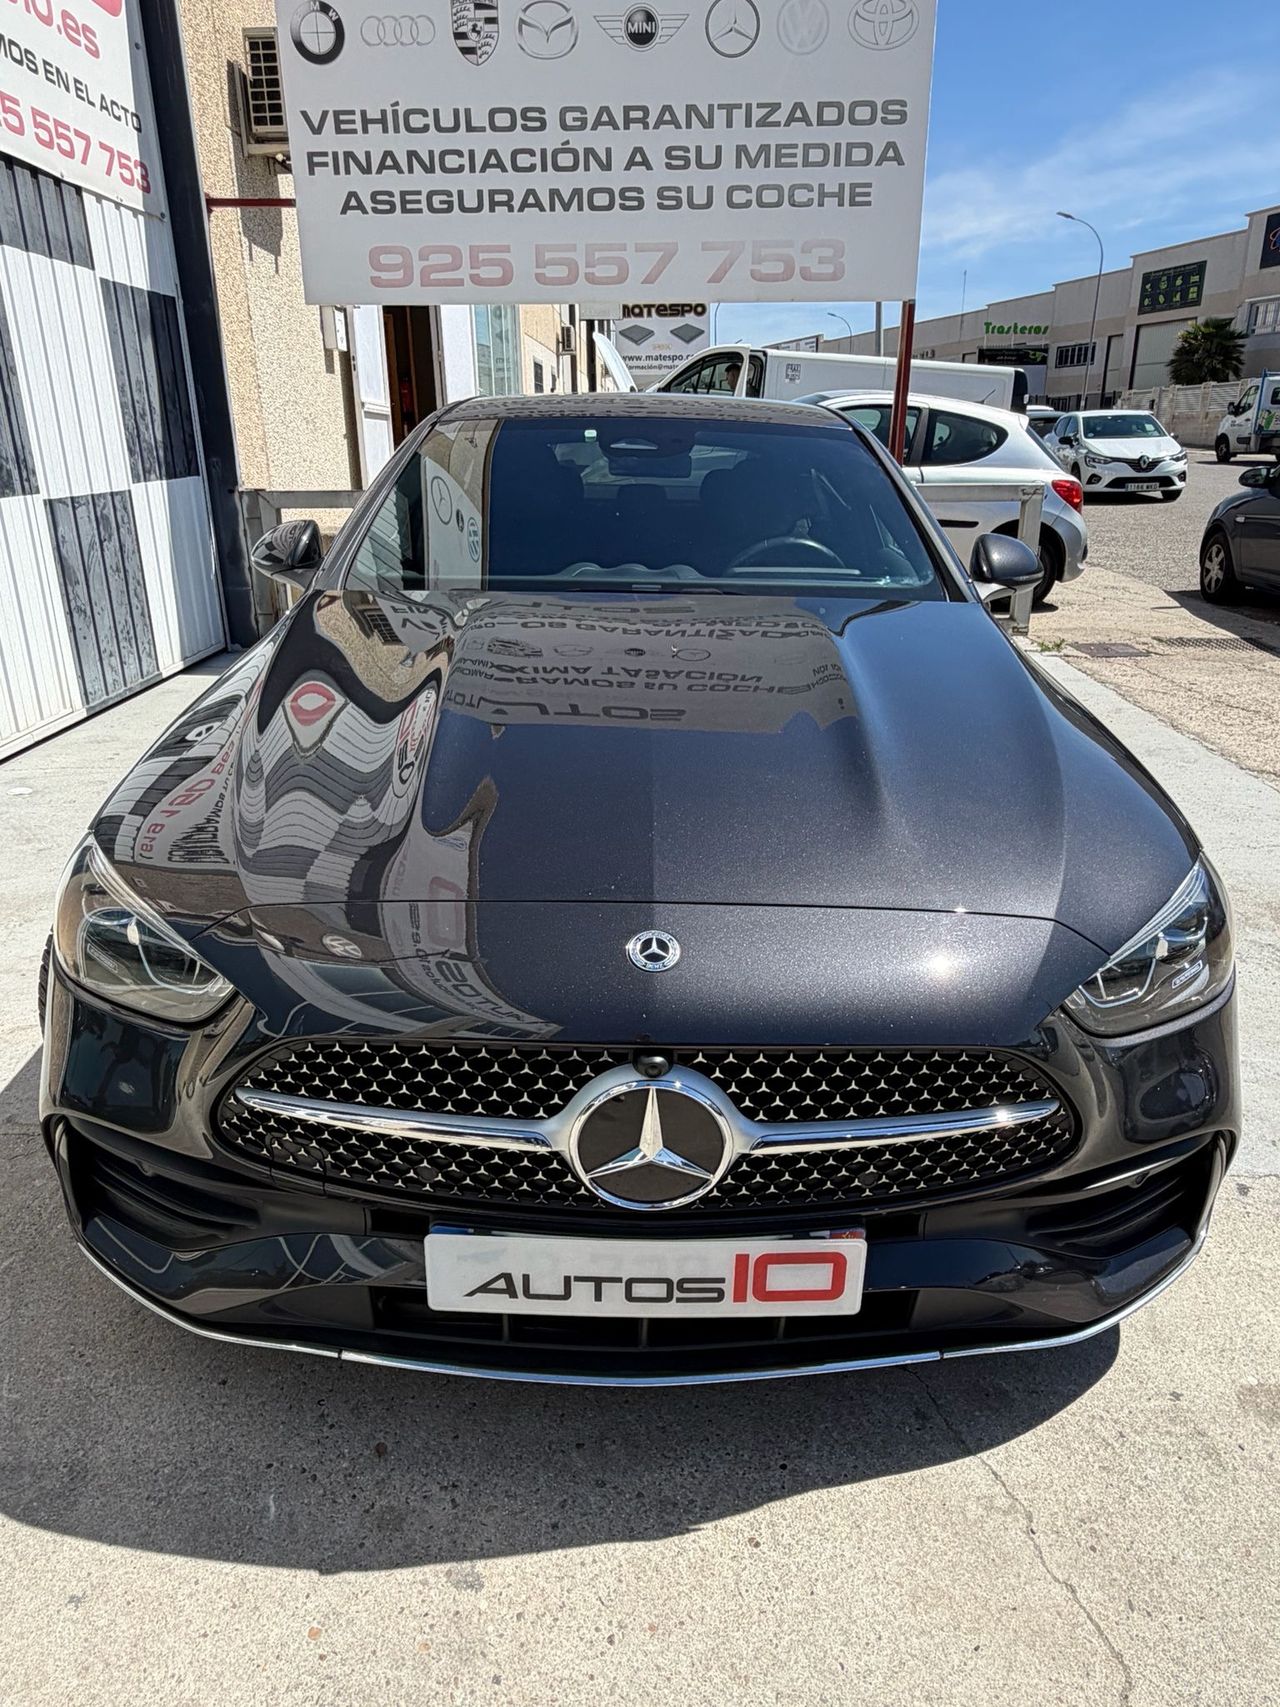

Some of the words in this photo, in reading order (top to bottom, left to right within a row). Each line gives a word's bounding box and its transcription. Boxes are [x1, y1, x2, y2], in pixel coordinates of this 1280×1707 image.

[628, 21, 656, 34] MINI
[42, 58, 71, 94] EN
[73, 77, 96, 107] EL
[100, 93, 142, 133] ACTO
[300, 101, 547, 135] VEHÍCULOS
[559, 99, 908, 132] GARANTIZADOS
[0, 91, 25, 137] 5
[31, 106, 91, 166] 557
[98, 140, 151, 194] 753
[306, 139, 613, 176] FINANCIACIÓN
[624, 146, 653, 171] A
[664, 145, 722, 170] SU
[735, 141, 905, 169] MEDIDA
[340, 187, 645, 215] ASEGURAMOS
[656, 185, 714, 211] SU
[726, 182, 873, 209] COCHE
[368, 244, 514, 289] 925
[534, 242, 679, 287] 557
[701, 239, 846, 284] 753
[984, 322, 1049, 335] Trasteros
[463, 1251, 848, 1304] AUTOS10
